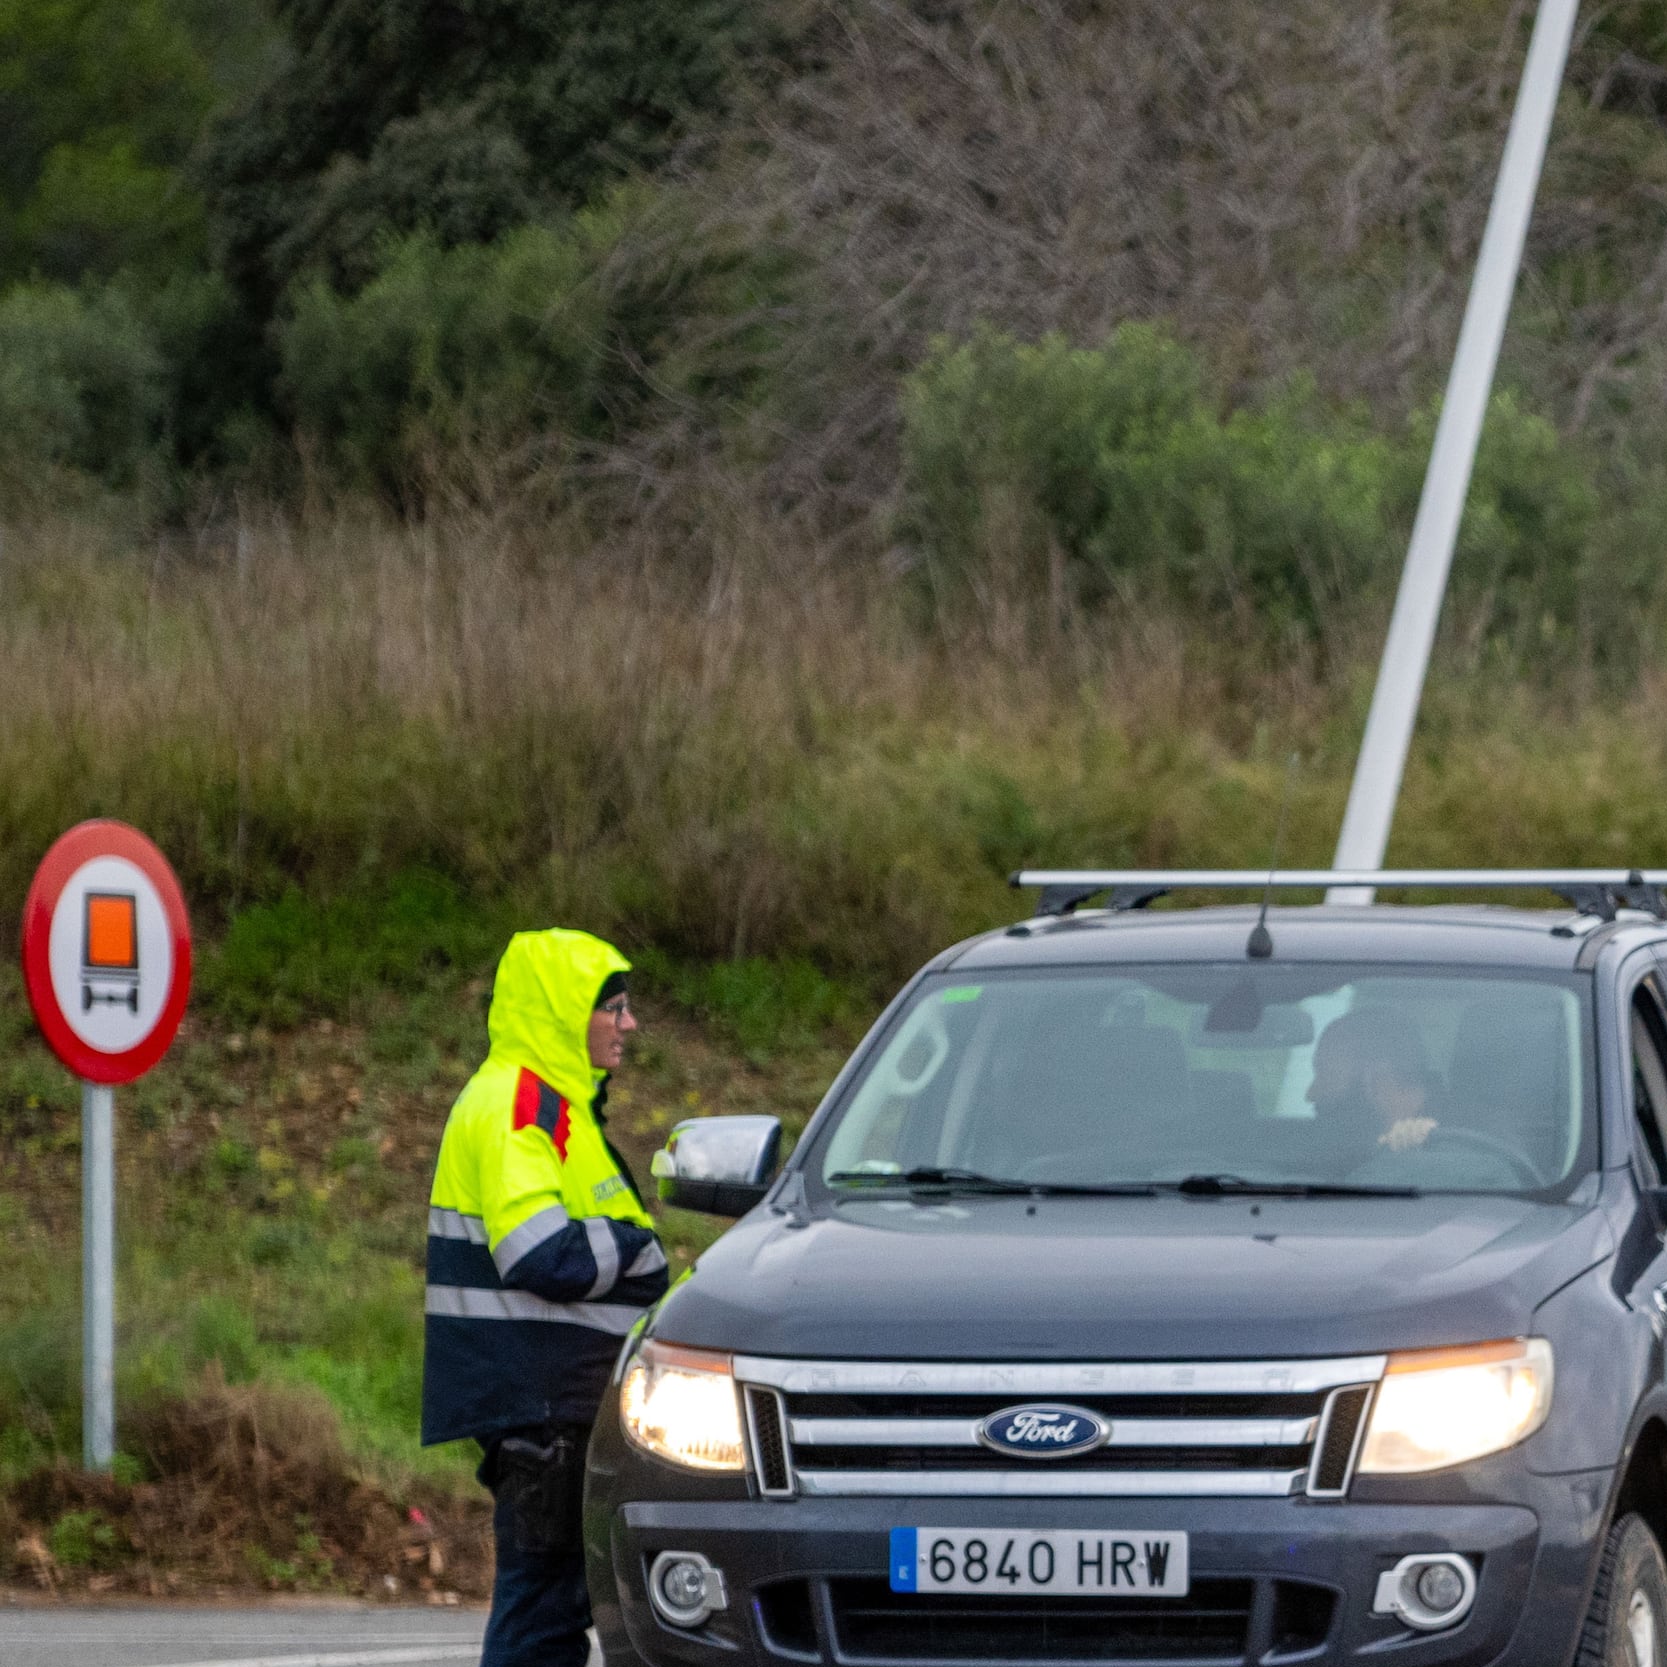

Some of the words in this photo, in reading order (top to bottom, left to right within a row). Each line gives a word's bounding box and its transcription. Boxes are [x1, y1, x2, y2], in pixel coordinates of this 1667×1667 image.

[1006, 1411, 1077, 1443] Ford
[929, 1539, 1056, 1585] 6840
[1077, 1540, 1171, 1587] HRW
